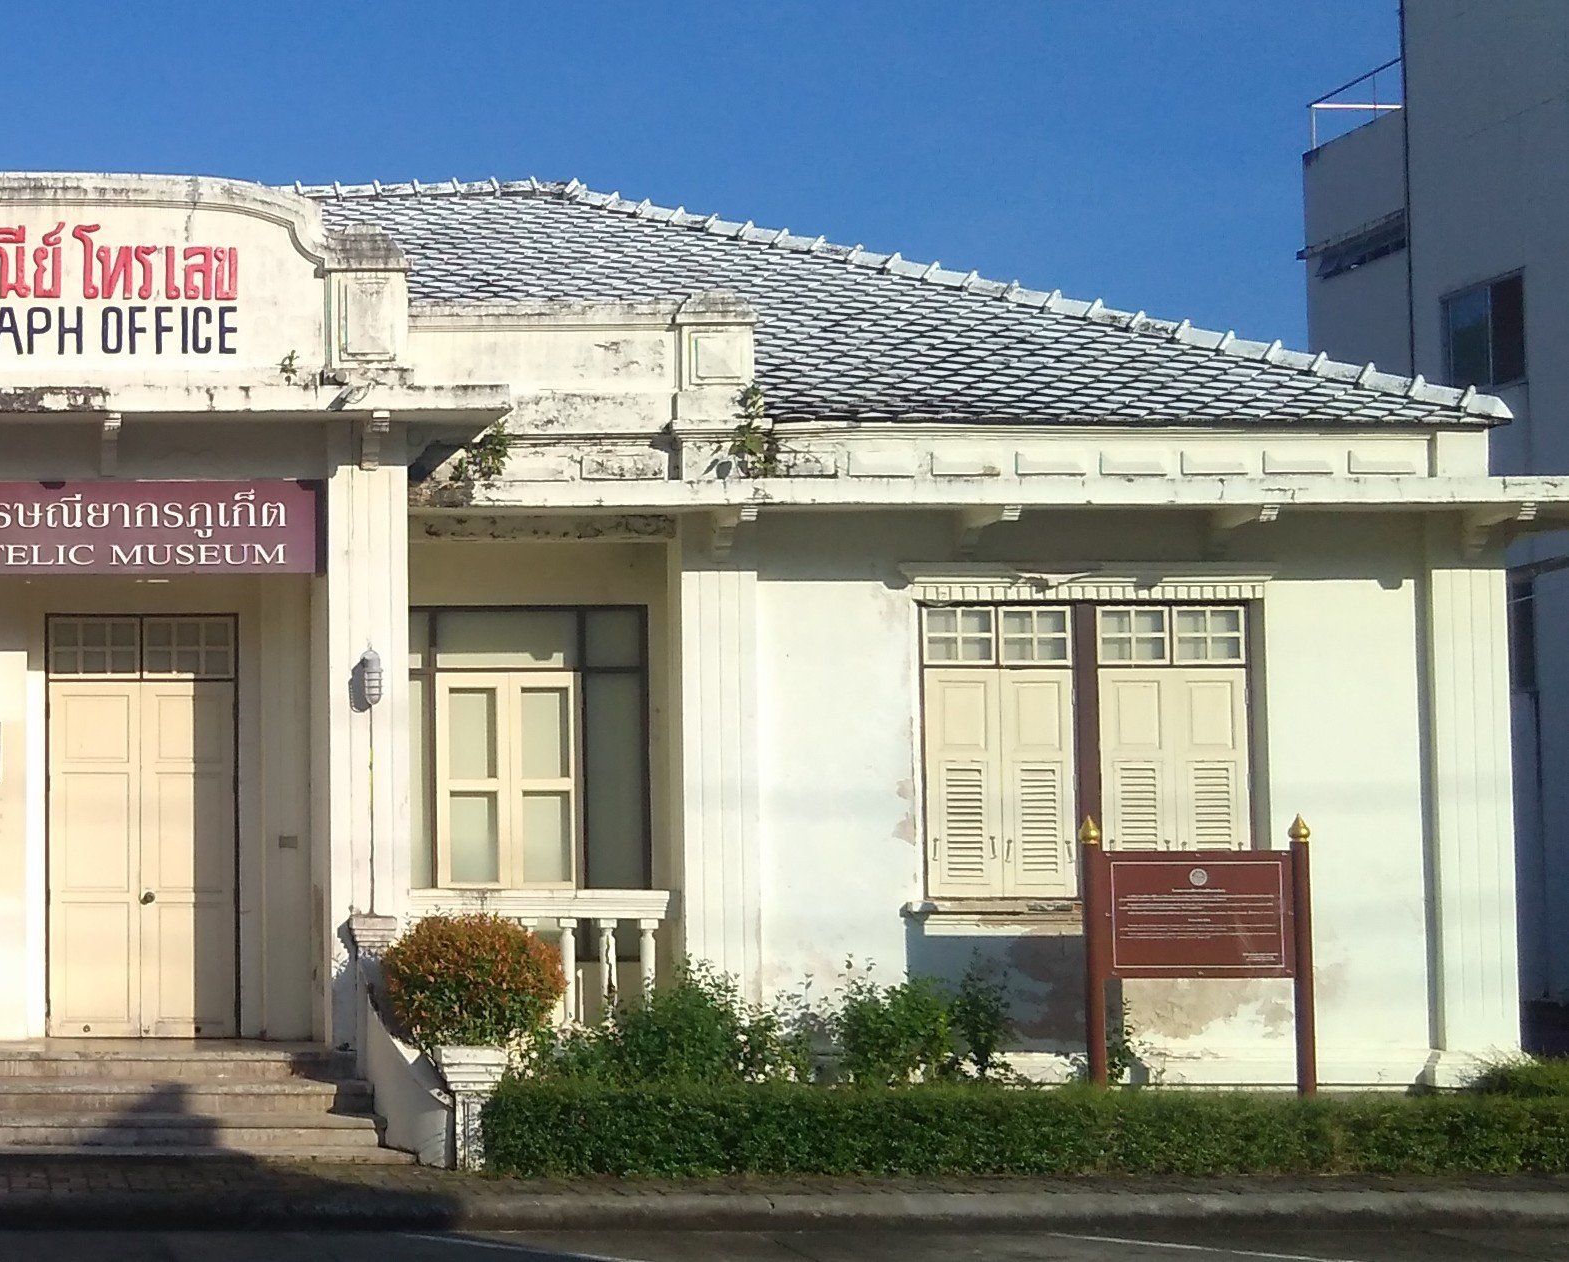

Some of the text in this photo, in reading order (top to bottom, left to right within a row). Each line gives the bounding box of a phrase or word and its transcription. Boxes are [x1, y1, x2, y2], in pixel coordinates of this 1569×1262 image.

[72, 223, 238, 301] โทรเลข
[101, 305, 238, 355] OFFICE
[109, 543, 286, 565] MUSEUM
